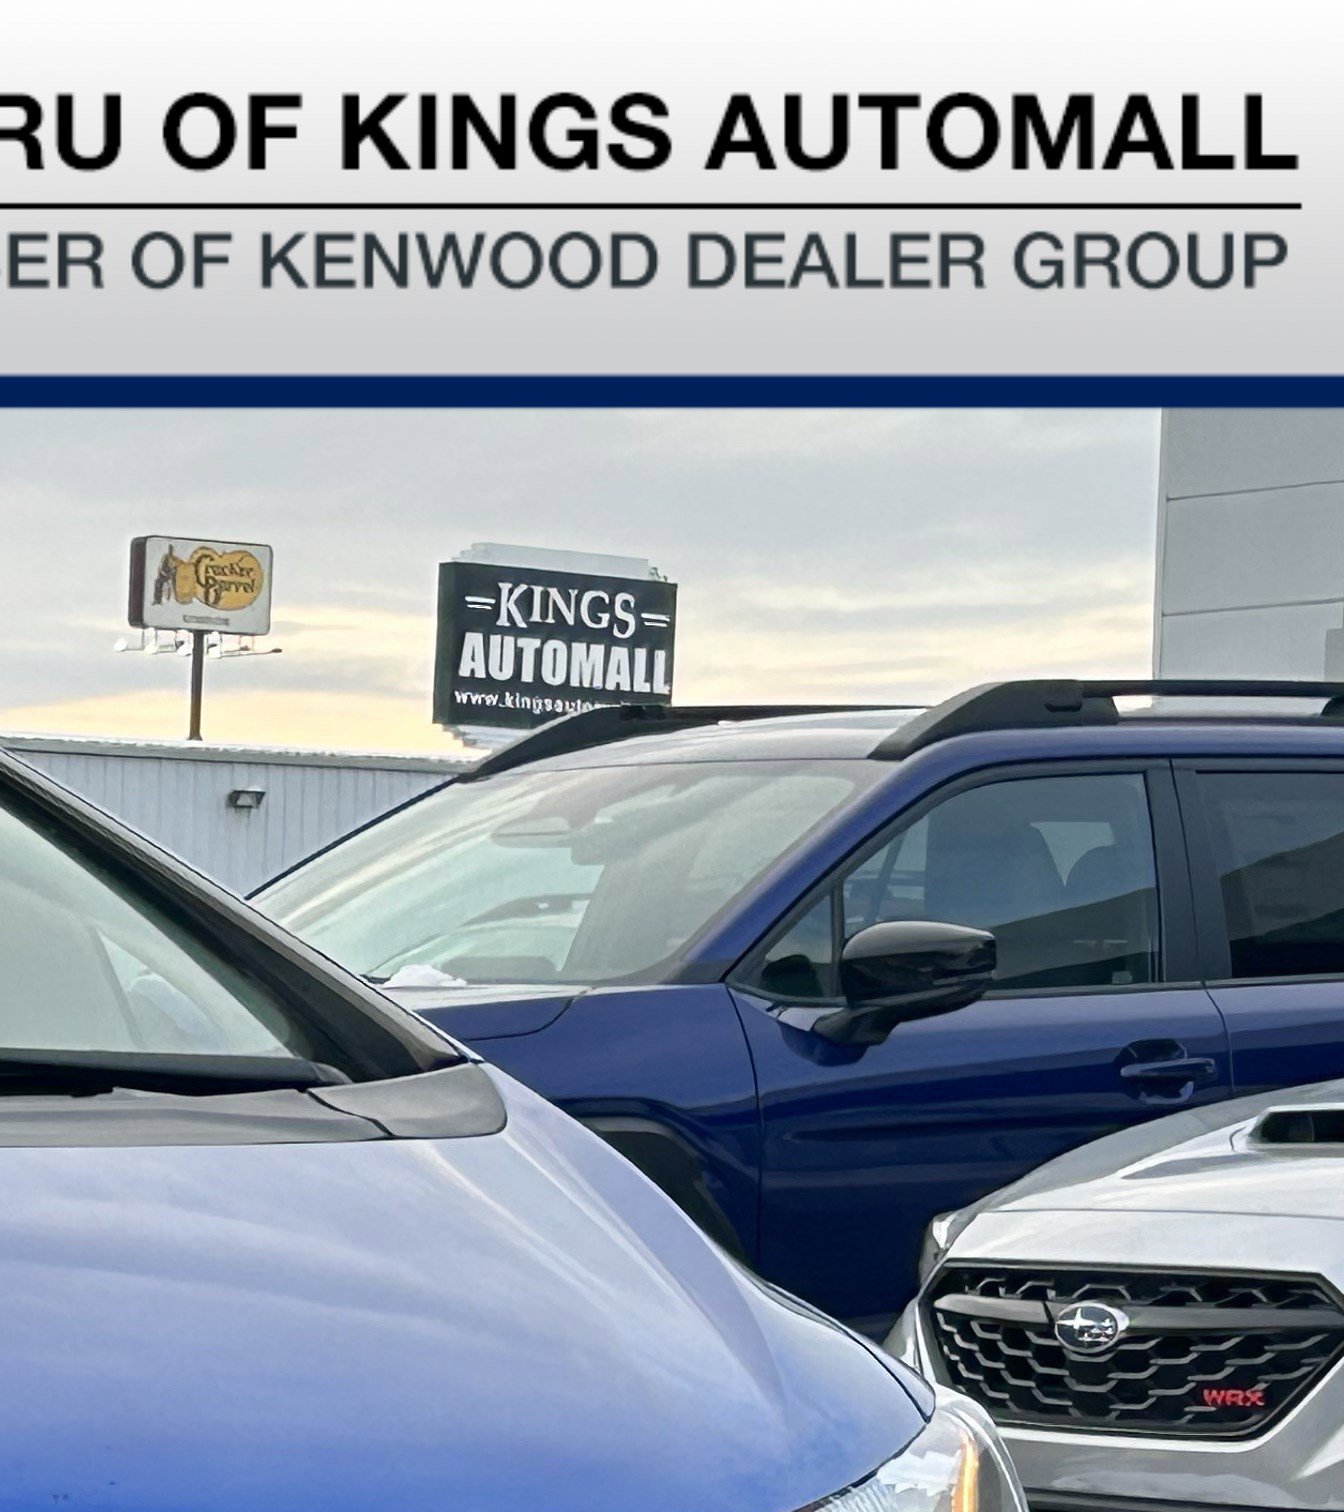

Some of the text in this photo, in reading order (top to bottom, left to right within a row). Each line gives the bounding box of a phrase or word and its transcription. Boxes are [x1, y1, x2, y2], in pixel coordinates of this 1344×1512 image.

[496, 582, 636, 639] KINGS
[458, 631, 670, 695] AUTOMALL
[1202, 1388, 1266, 1407] WRX
